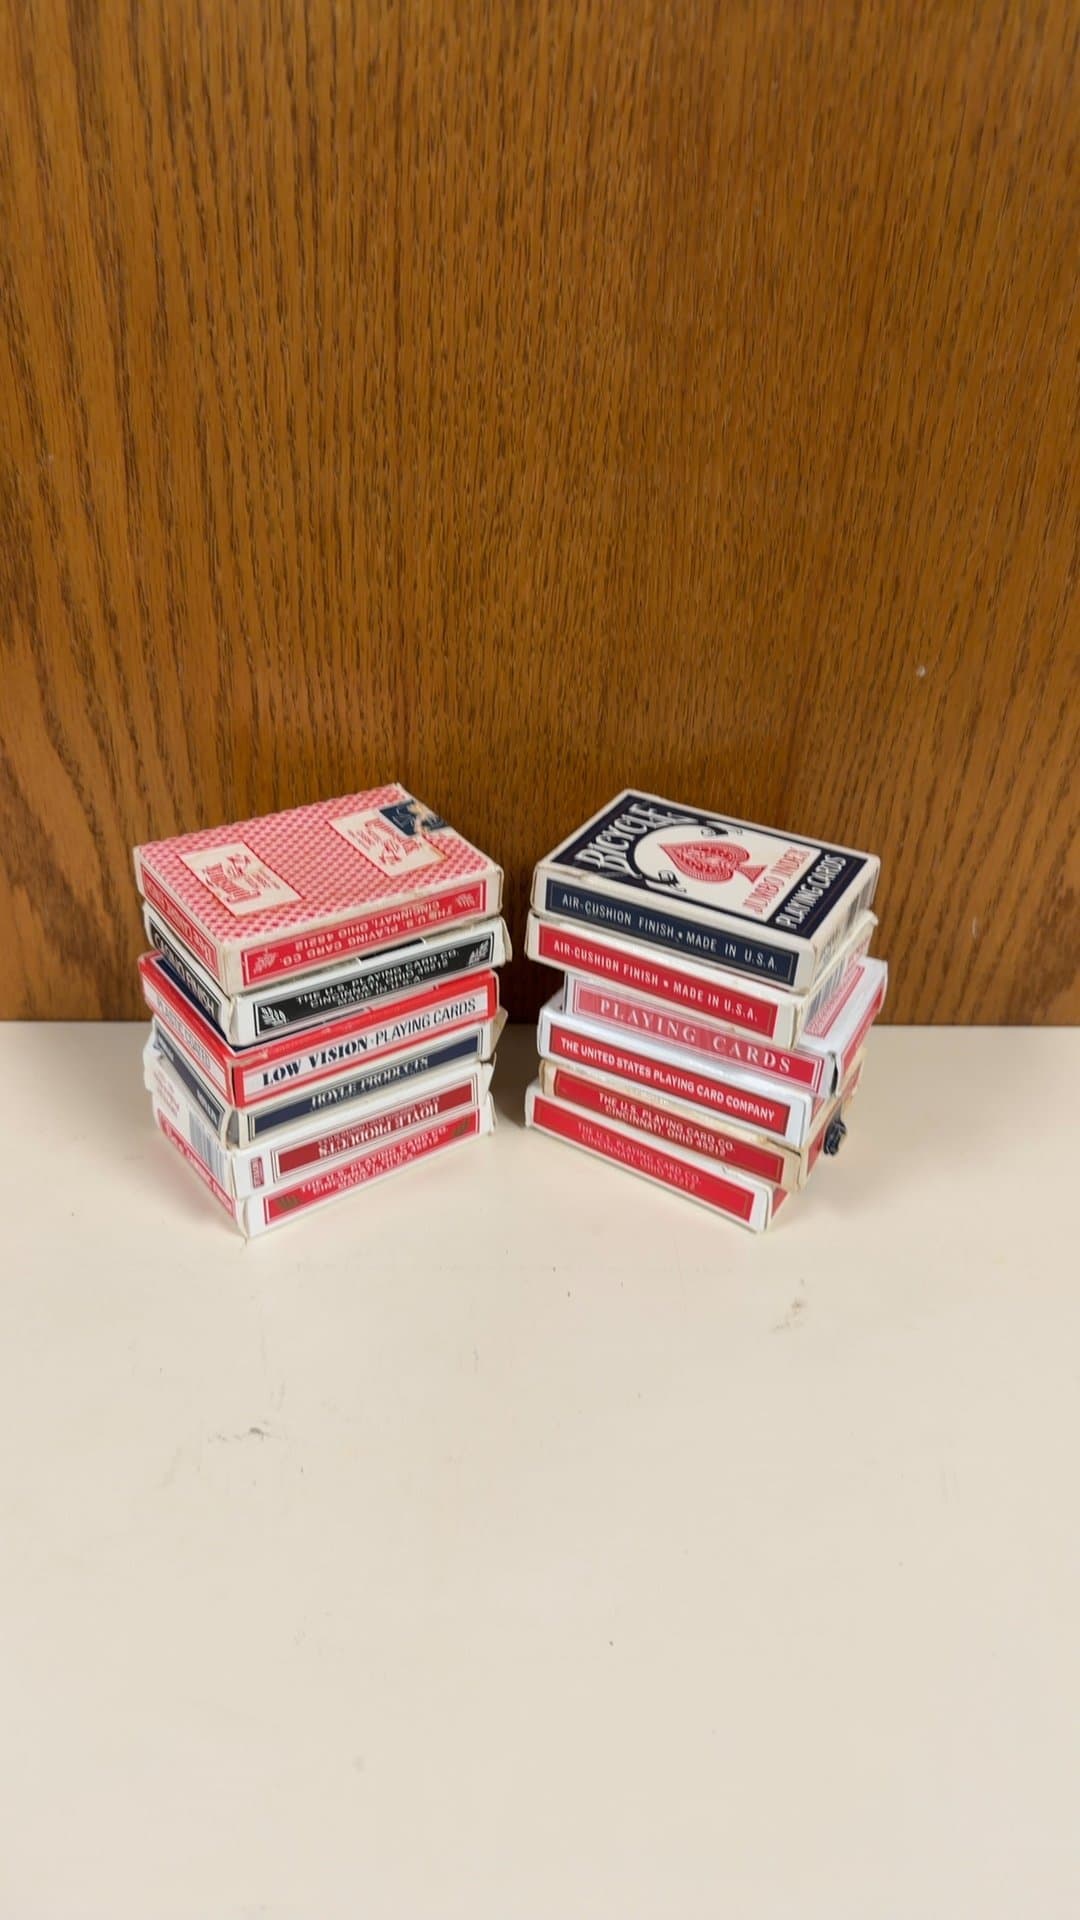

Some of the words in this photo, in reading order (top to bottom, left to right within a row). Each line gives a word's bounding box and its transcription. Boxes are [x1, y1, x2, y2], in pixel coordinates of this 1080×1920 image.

[574, 803, 699, 880] BICYCLE
[743, 876, 784, 915] JUMBO
[770, 846, 810, 880] INDEX
[775, 884, 823, 929] PLAYING
[807, 854, 846, 888] CARDS
[338, 921, 368, 939] OHIO
[347, 923, 397, 947] PLAYING
[371, 900, 439, 929] CINCINNATI,
[428, 905, 452, 922] THE
[562, 893, 631, 926] AIR-CUSHION
[638, 916, 674, 939] FINISH
[686, 931, 717, 952] MADE
[724, 943, 737, 958] IN
[743, 948, 778, 971] U.S.A.
[306, 940, 341, 959] CARD
[296, 989, 320, 1005] THE
[351, 965, 401, 988] PLAYING
[405, 954, 436, 971] CARD
[553, 939, 618, 973] AIR-CUSHION
[623, 963, 658, 987] FINISH
[673, 981, 703, 1002] MADE
[707, 992, 719, 1008] IN
[724, 998, 758, 1022] U.S.A.
[262, 1059, 301, 1086] LOW
[308, 1035, 368, 1070] VISION
[374, 1013, 429, 1046] PLAYING
[433, 996, 475, 1025] CARDS
[600, 998, 696, 1044] PLAYING
[712, 1033, 791, 1074] CARDS
[311, 1080, 356, 1108] HOYLE
[361, 1055, 428, 1089] PRODUCTS
[561, 1036, 578, 1054] THE
[581, 1043, 614, 1067] UNITED
[616, 1055, 651, 1079] STATES
[653, 1068, 694, 1095] PLAYING
[696, 1084, 724, 1105] CARD
[725, 1094, 774, 1123] COMPANY
[317, 1120, 391, 1157] PRODUCTS
[394, 1102, 438, 1129] HOYLE
[599, 1091, 616, 1108] THE
[620, 1100, 638, 1116] U.S.
[641, 1108, 683, 1134] PLAYING
[686, 1125, 715, 1146] CARD
[605, 1103, 664, 1135] CINCINNATI,
[666, 1127, 693, 1146] OHIO
